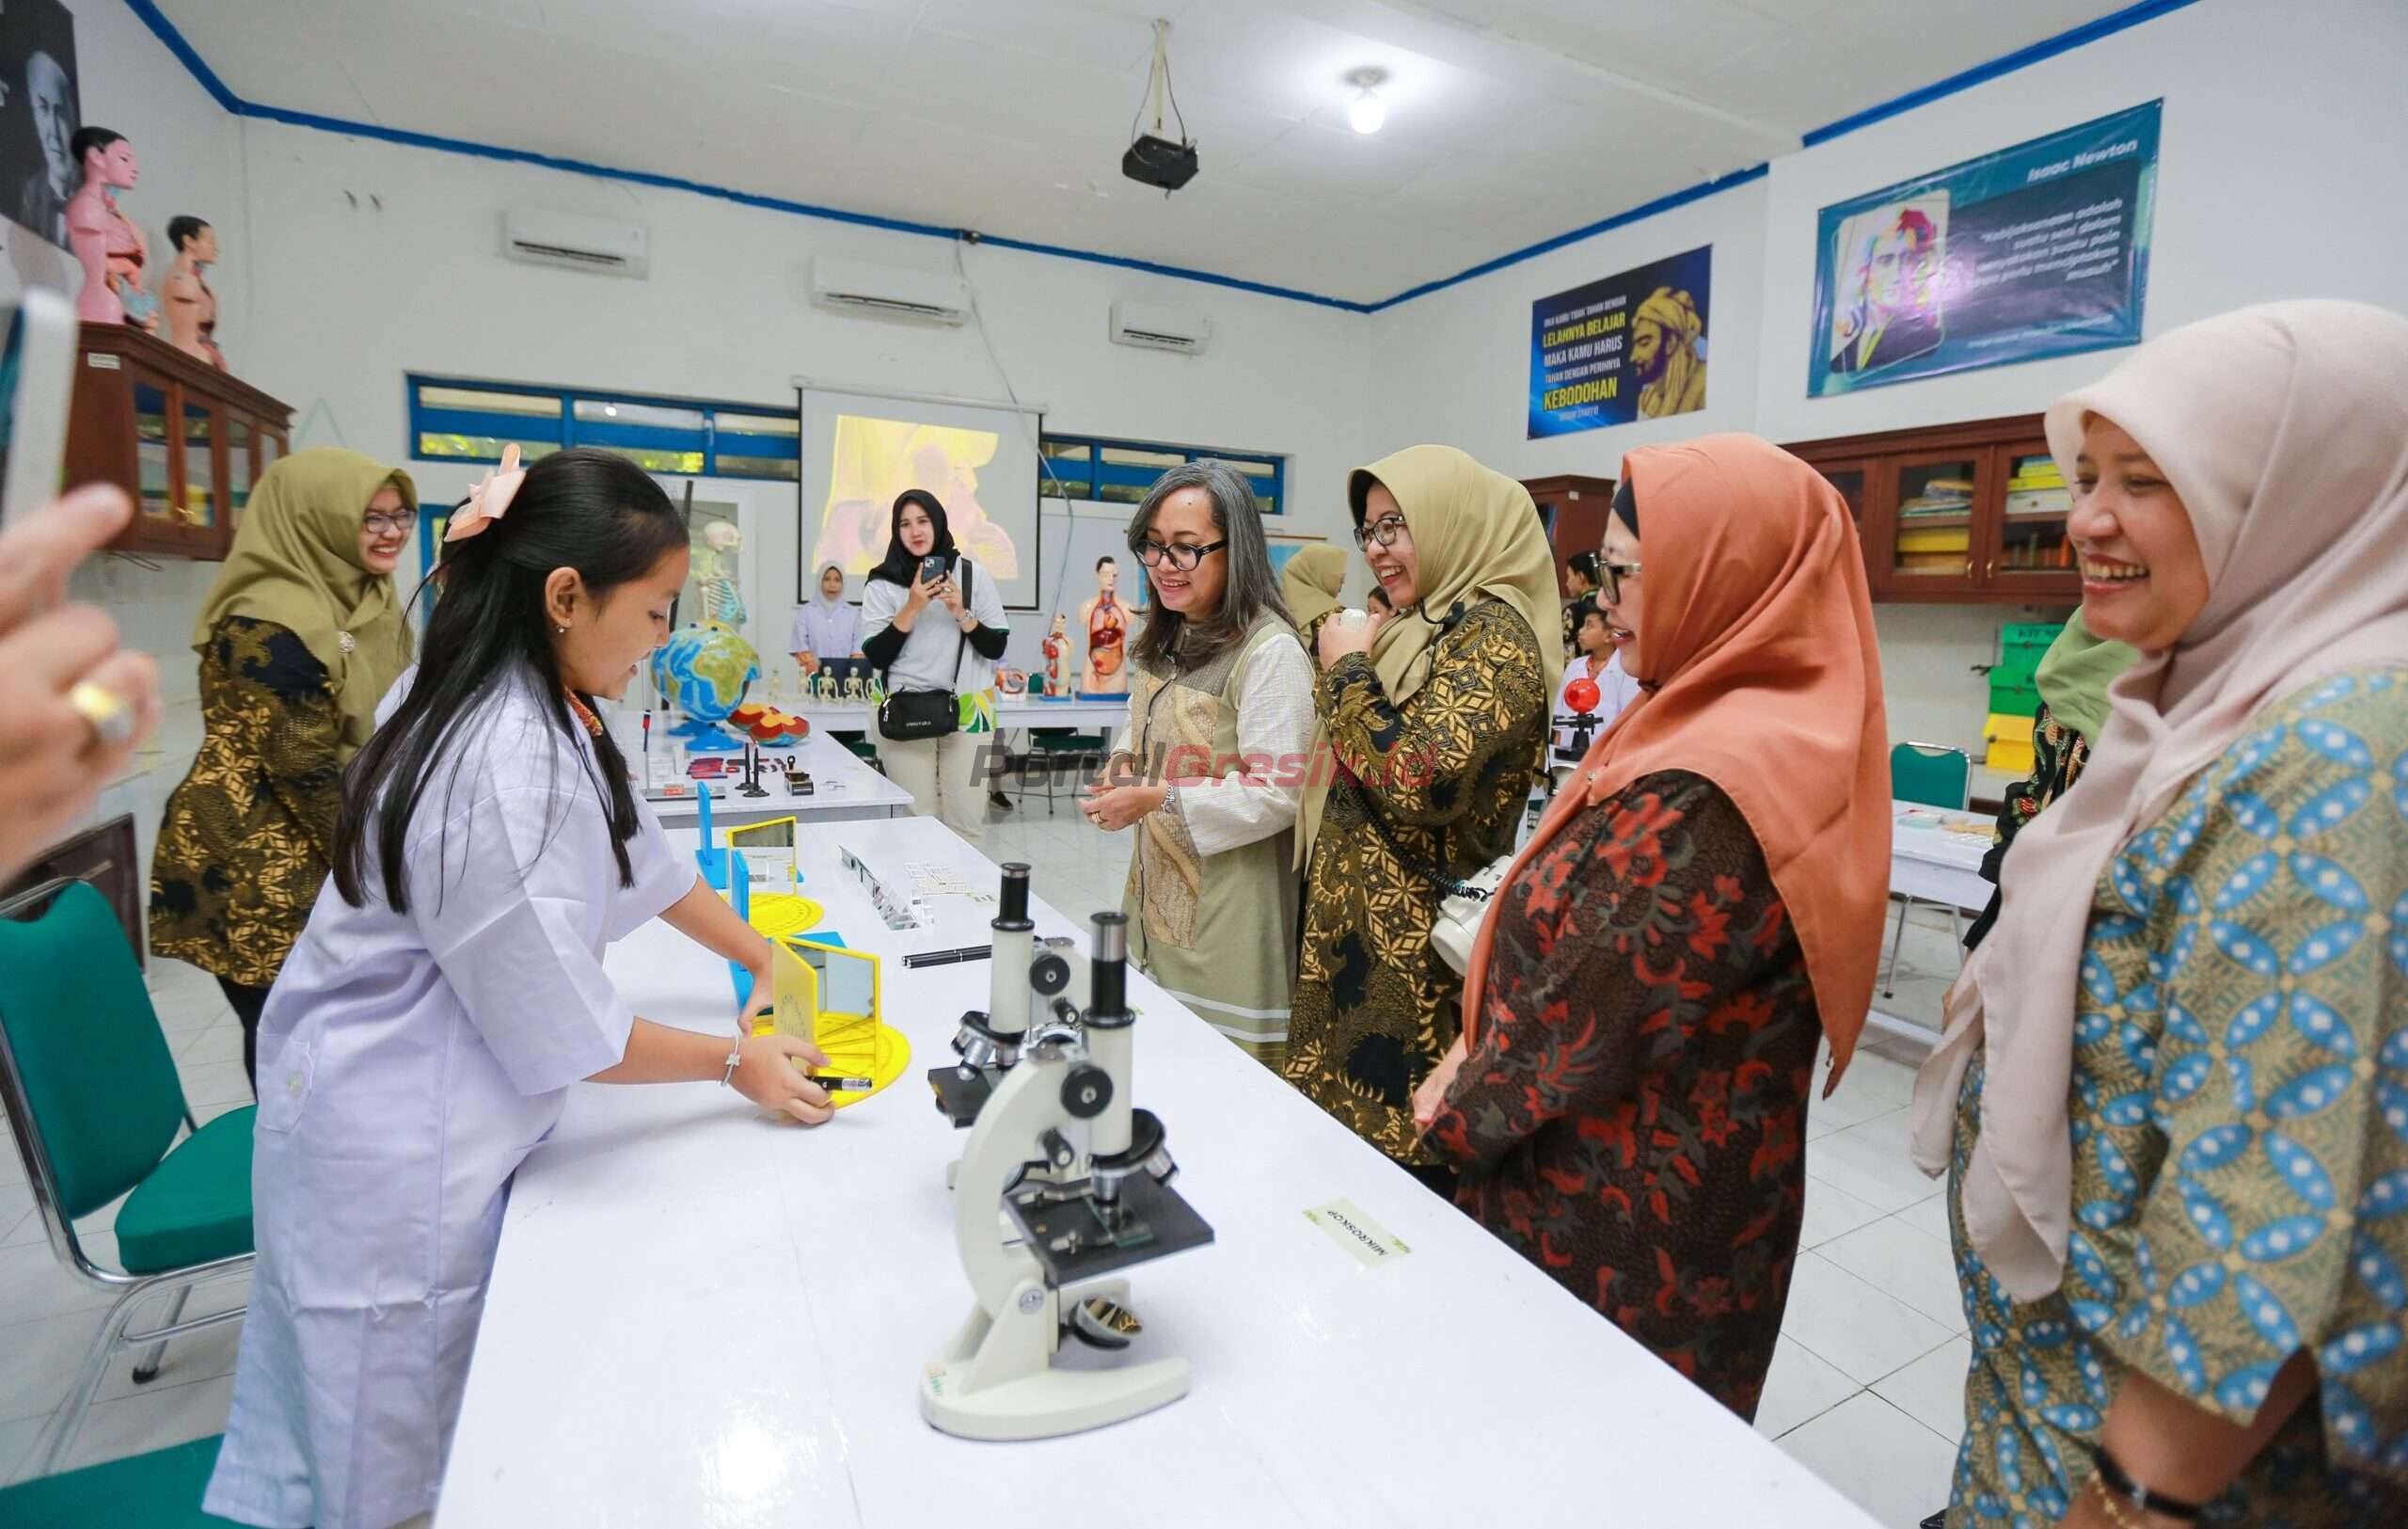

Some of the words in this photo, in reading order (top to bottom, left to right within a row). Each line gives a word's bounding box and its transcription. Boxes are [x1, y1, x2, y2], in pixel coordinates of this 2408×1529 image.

[2027, 159, 2070, 183] Isaac
[2072, 139, 2138, 168] Newton
[2075, 198, 2122, 219] adalah
[2078, 215, 2121, 234] dalam
[1544, 324, 1586, 348] LELAHNYA
[1587, 311, 1625, 337] BELAJAR
[1544, 350, 1567, 368] MAKA
[1568, 343, 1593, 361] KAMU
[1593, 334, 1624, 356] HARUS
[1564, 366, 1589, 381] DENGAN
[1590, 357, 1621, 375] PERIHNYA
[1544, 375, 1618, 411] KEBODOHAN
[1327, 1210, 1388, 1256] MIKROSKOP
